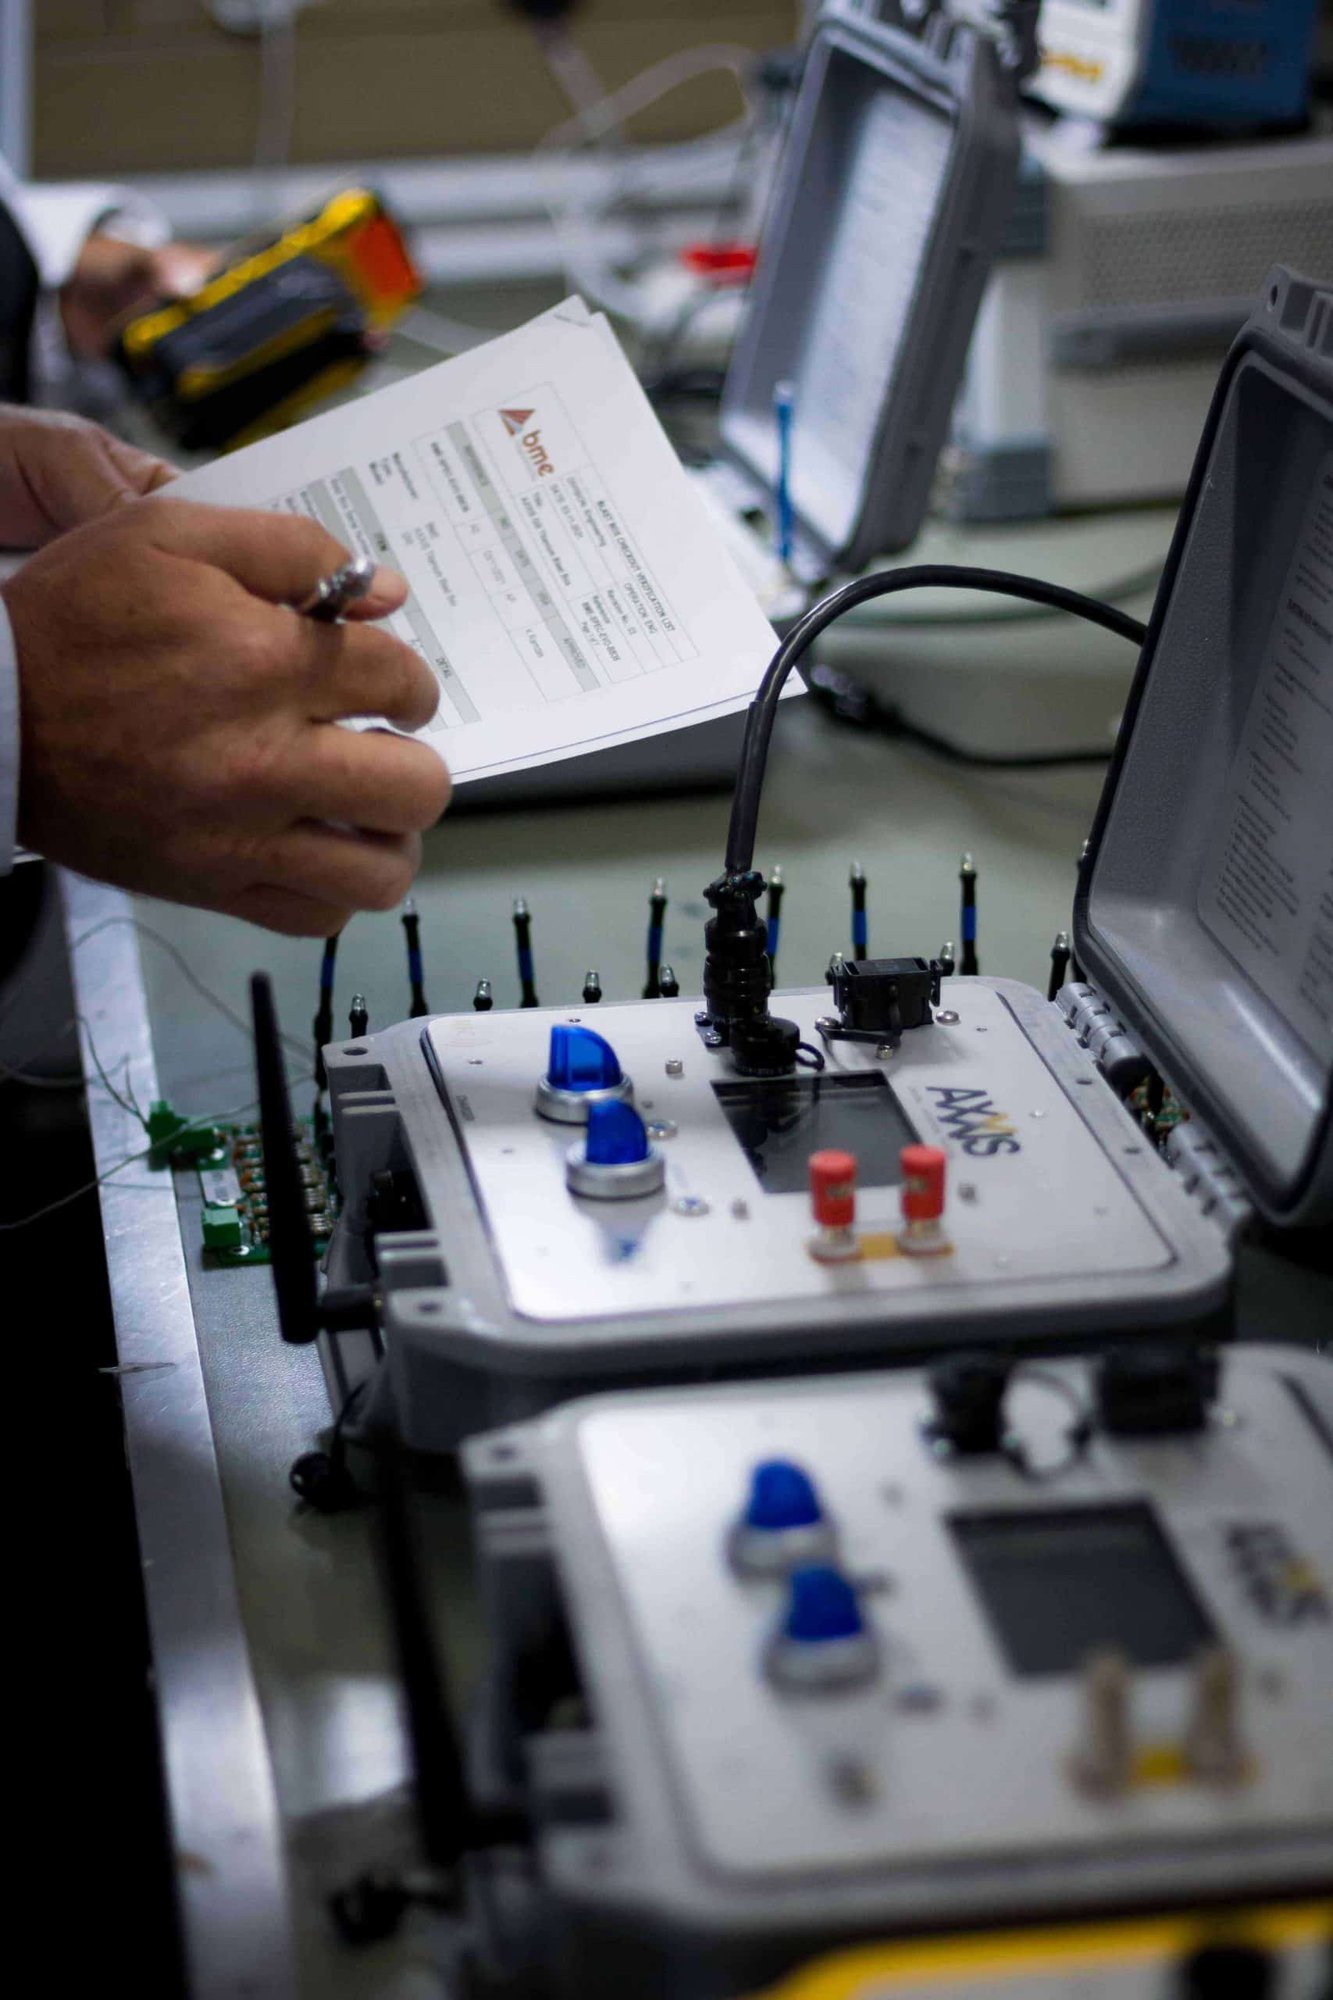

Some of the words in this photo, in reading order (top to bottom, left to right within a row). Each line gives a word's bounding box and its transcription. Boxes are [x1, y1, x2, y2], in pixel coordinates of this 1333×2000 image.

[521, 429, 554, 476] bme
[616, 537, 640, 570] CHECKOUT
[636, 572, 665, 617] VERIFICATION
[661, 617, 675, 631] LIST
[644, 619, 657, 633] ENG
